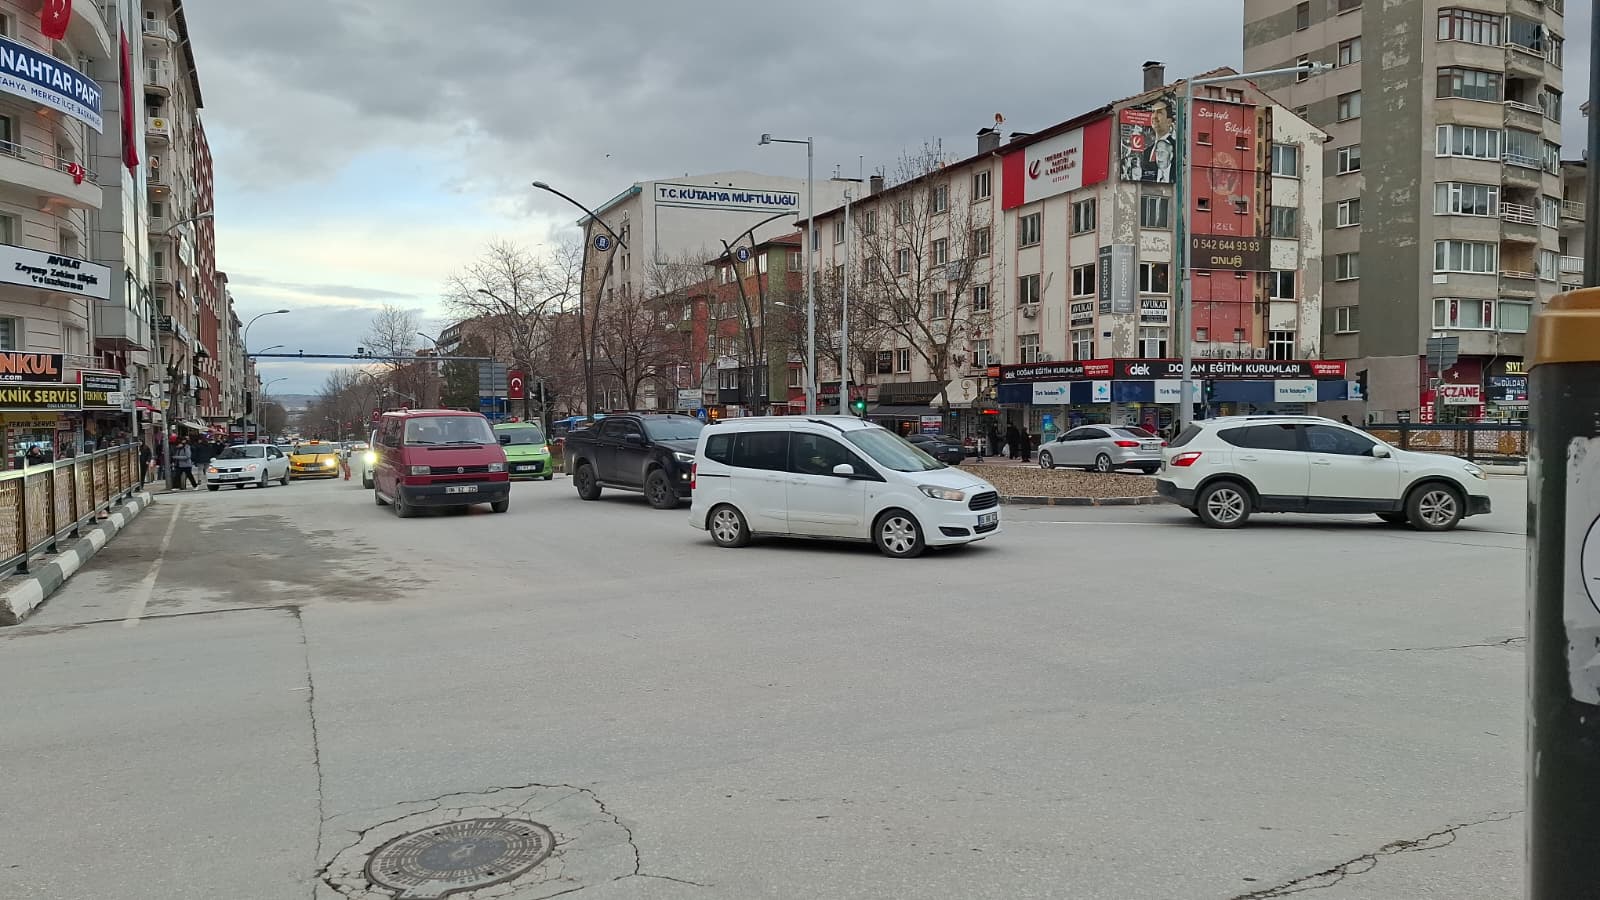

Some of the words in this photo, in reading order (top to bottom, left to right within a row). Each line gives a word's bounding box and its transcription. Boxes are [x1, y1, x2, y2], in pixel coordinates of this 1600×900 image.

[31, 87, 61, 105] MERKEZ
[659, 188, 679, 198] T.C.
[680, 189, 730, 202] KÜTAHYA
[732, 191, 796, 206] MÜFTÜLÜĞÜ
[1193, 238, 1199, 249] 0
[1201, 239, 1217, 250] 542
[1219, 240, 1235, 251] 644
[1236, 241, 1247, 251] 93
[1249, 242, 1260, 252] 93
[1142, 300, 1166, 309] AVUKAT
[1053, 366, 1084, 374] KURUMLARI
[1130, 363, 1151, 376] dek
[1168, 363, 1205, 373] DOAN
[1209, 362, 1243, 373] EĞİTİM
[1245, 364, 1300, 373] KURUMLARI
[34, 388, 77, 402] SERVİS
